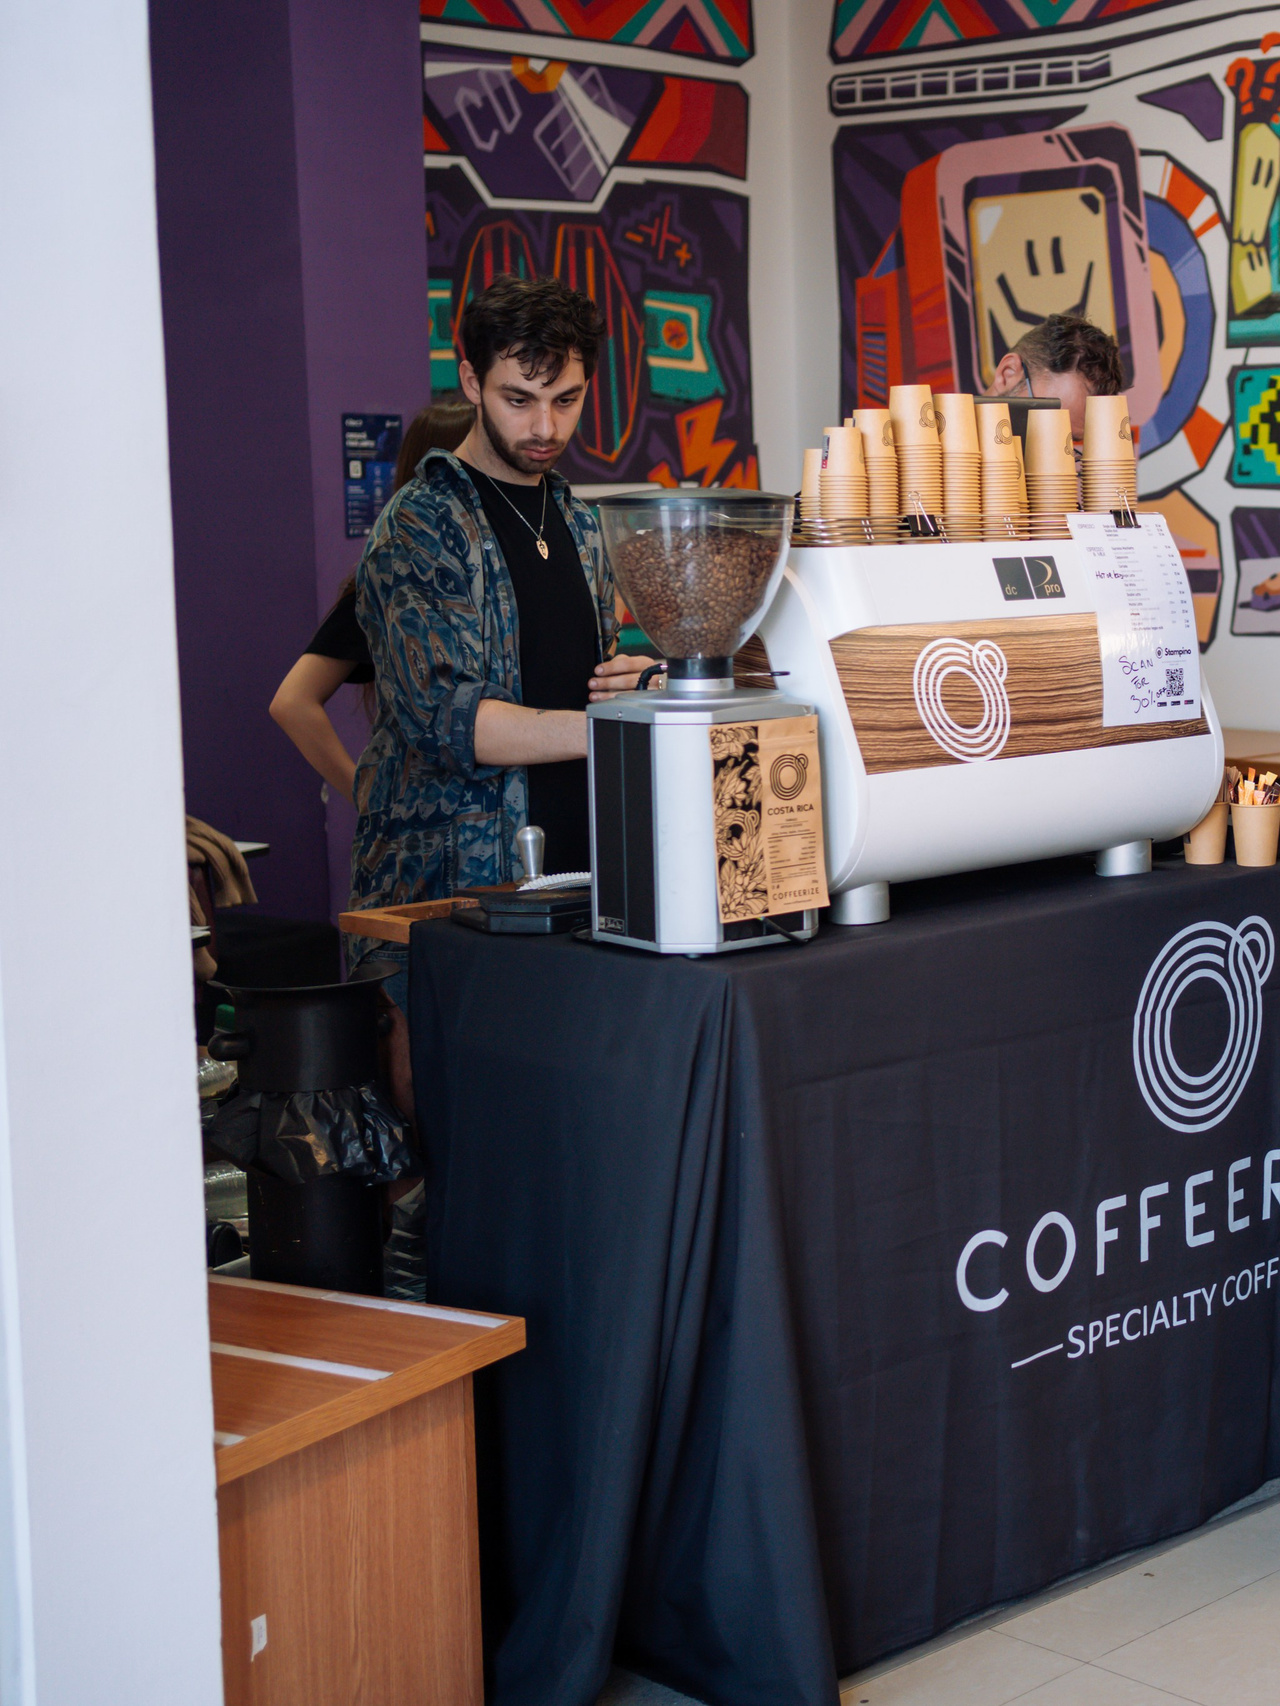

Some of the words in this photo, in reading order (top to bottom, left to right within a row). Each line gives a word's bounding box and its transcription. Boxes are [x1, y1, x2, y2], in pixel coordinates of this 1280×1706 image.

[1005, 584, 1018, 595] dc
[1044, 583, 1061, 596] pro
[1164, 647, 1191, 657] Stampino
[767, 806, 795, 816] COSTA
[796, 803, 815, 812] RICA
[772, 886, 820, 901] COFFEERIZE
[1066, 1283, 1218, 1359] SPECIALTY
